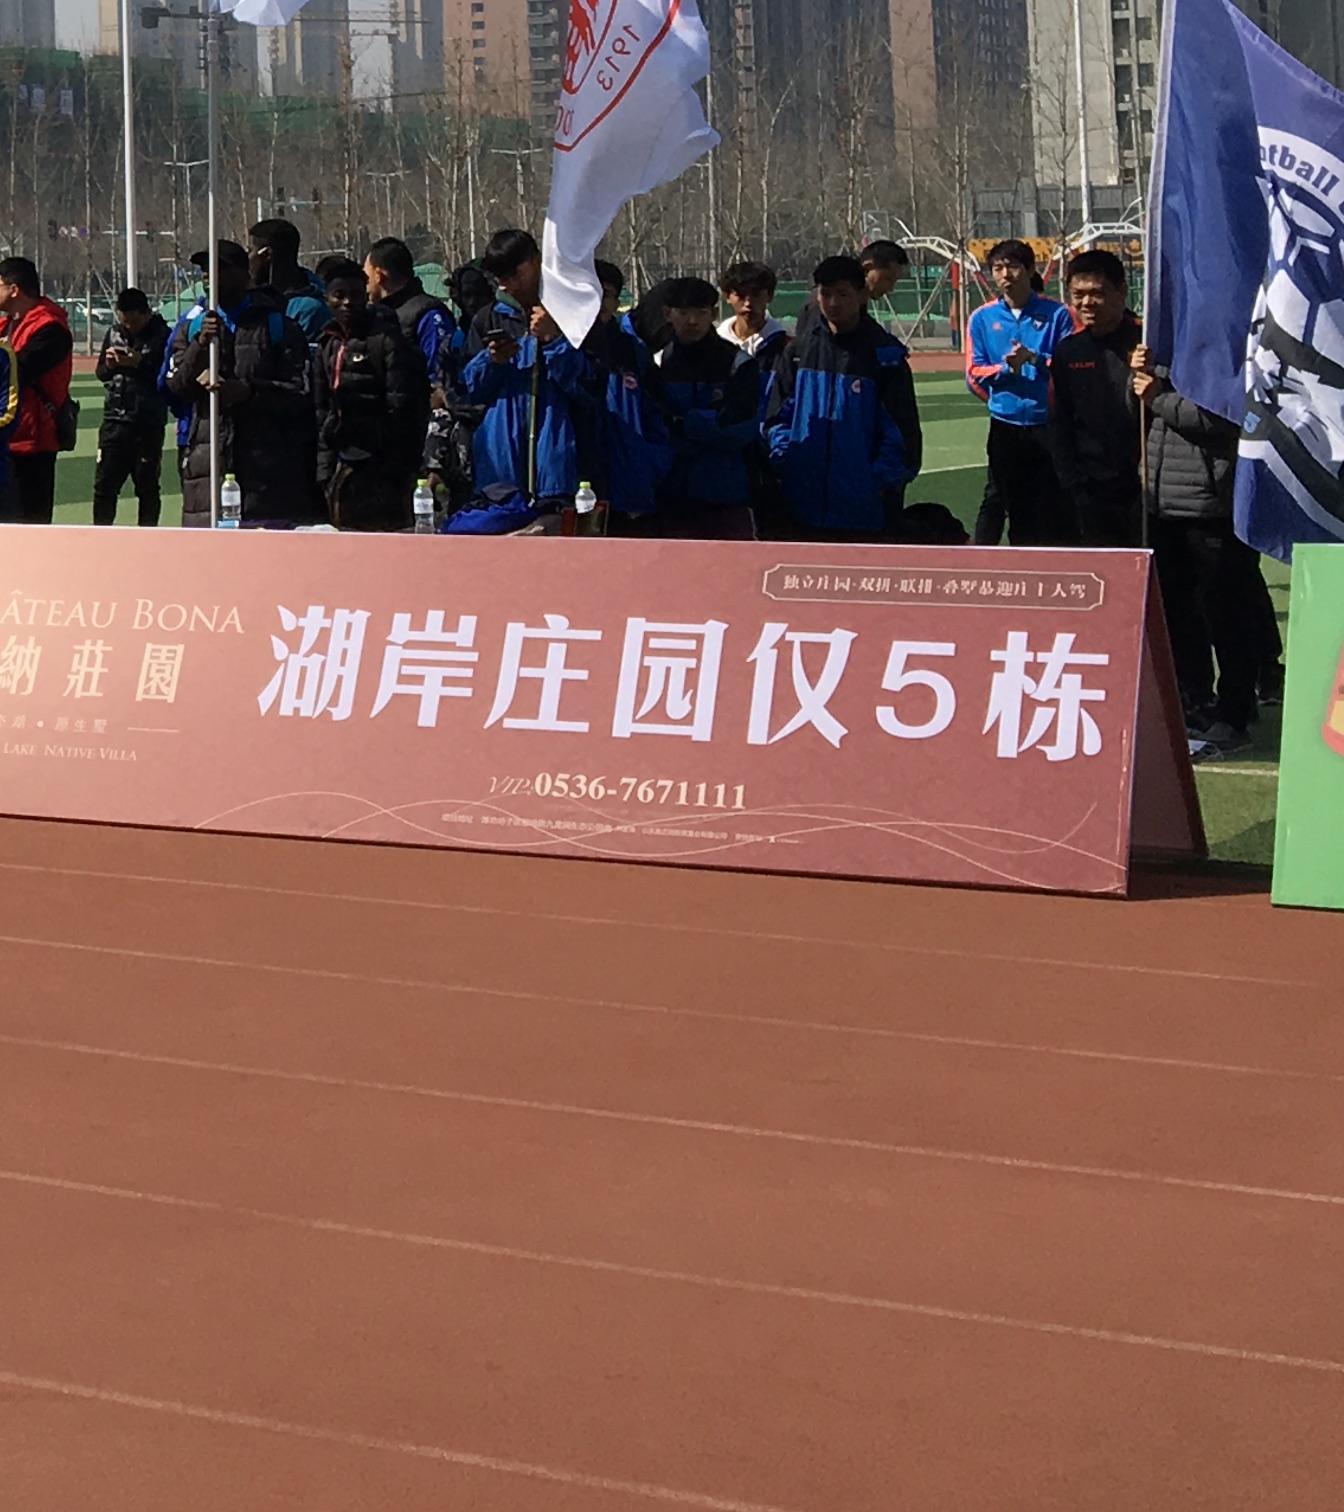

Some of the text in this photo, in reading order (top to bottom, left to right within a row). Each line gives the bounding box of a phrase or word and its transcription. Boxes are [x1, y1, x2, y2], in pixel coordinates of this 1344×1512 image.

[257, 604, 1109, 762] 湖岸庄园仅5栋
